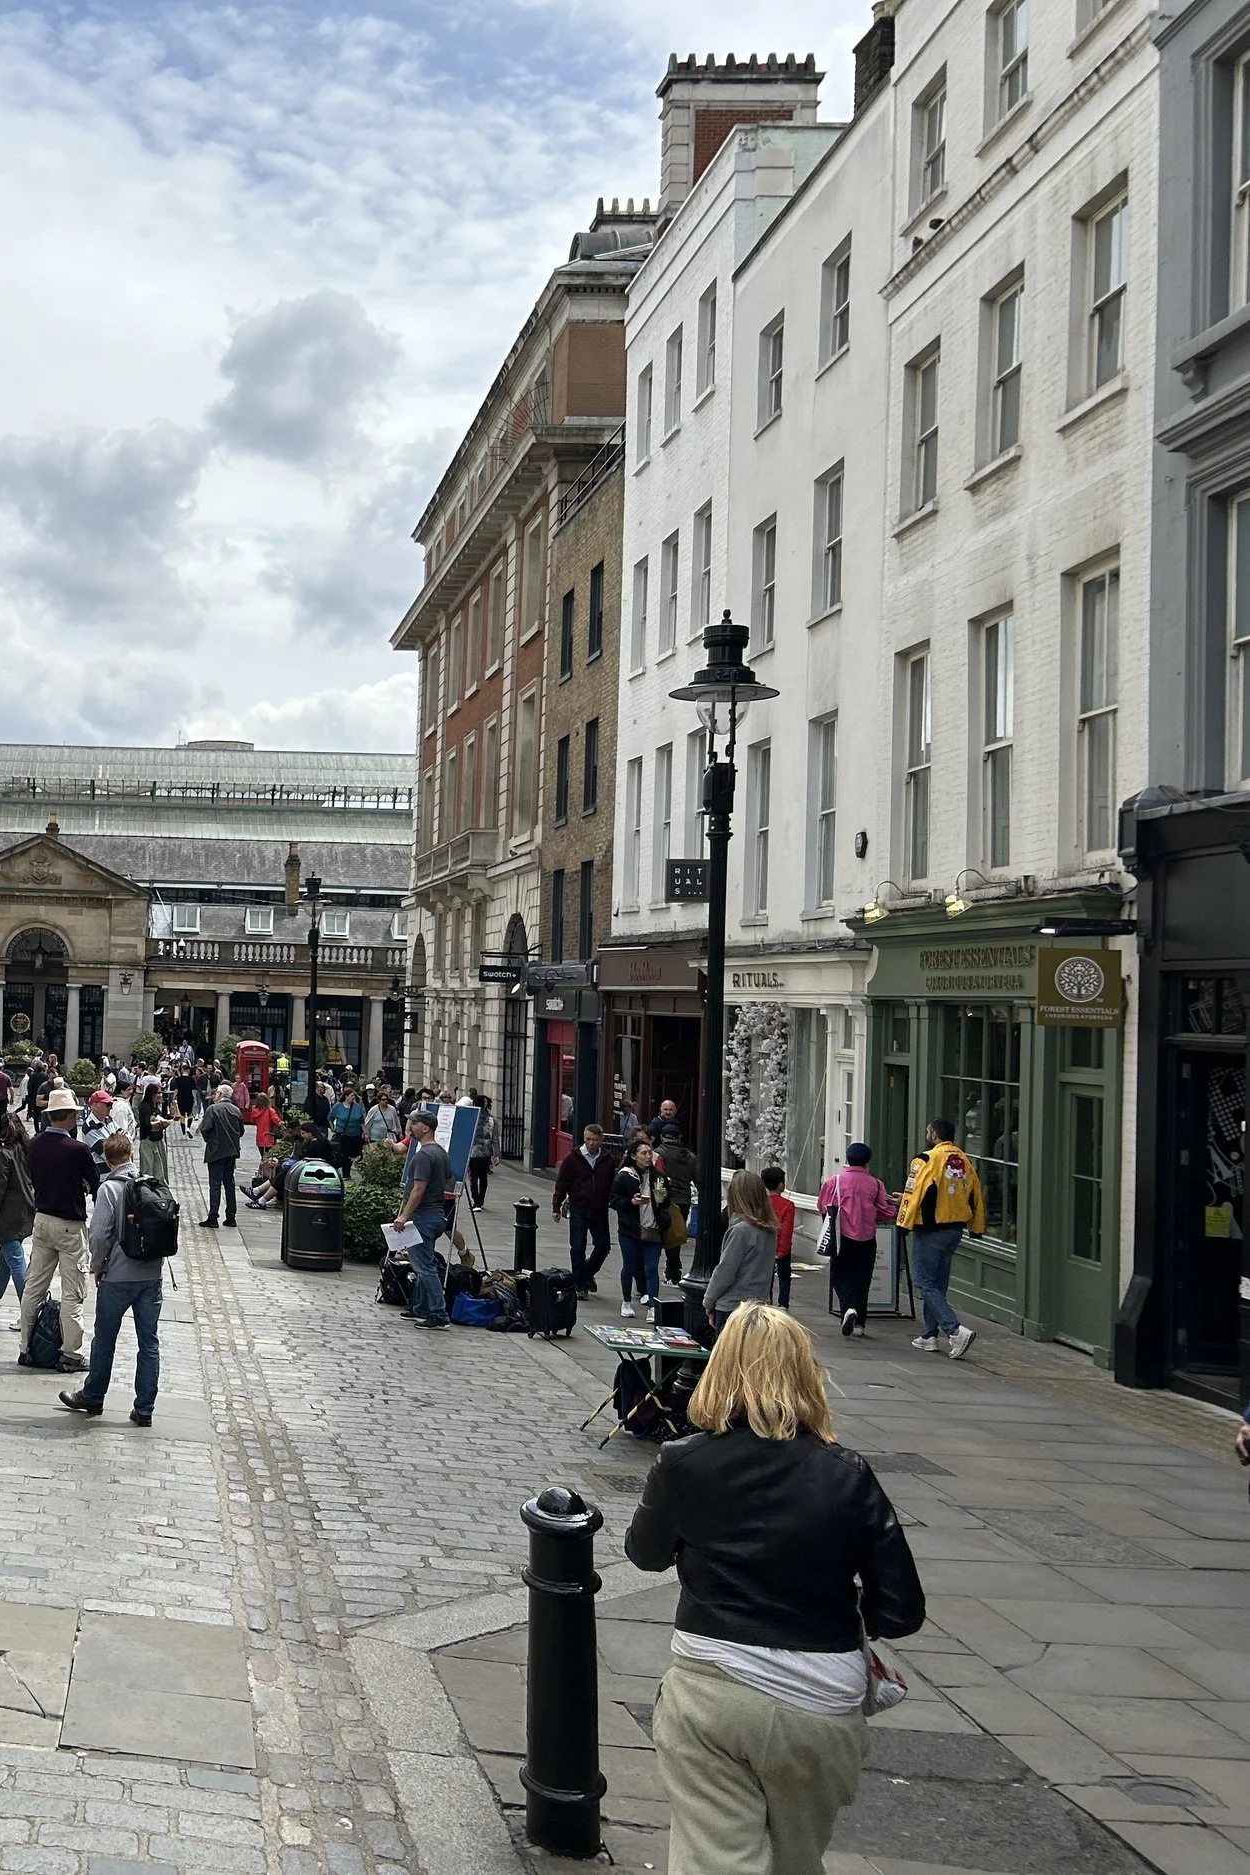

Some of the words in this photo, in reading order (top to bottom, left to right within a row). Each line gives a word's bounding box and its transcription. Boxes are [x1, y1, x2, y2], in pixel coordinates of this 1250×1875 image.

[919, 949, 959, 969] FOREST
[960, 944, 1035, 968] ESSENTIALS
[1039, 1005, 1070, 1013] FOREST
[1071, 1007, 1119, 1015] ESSENTIALS
